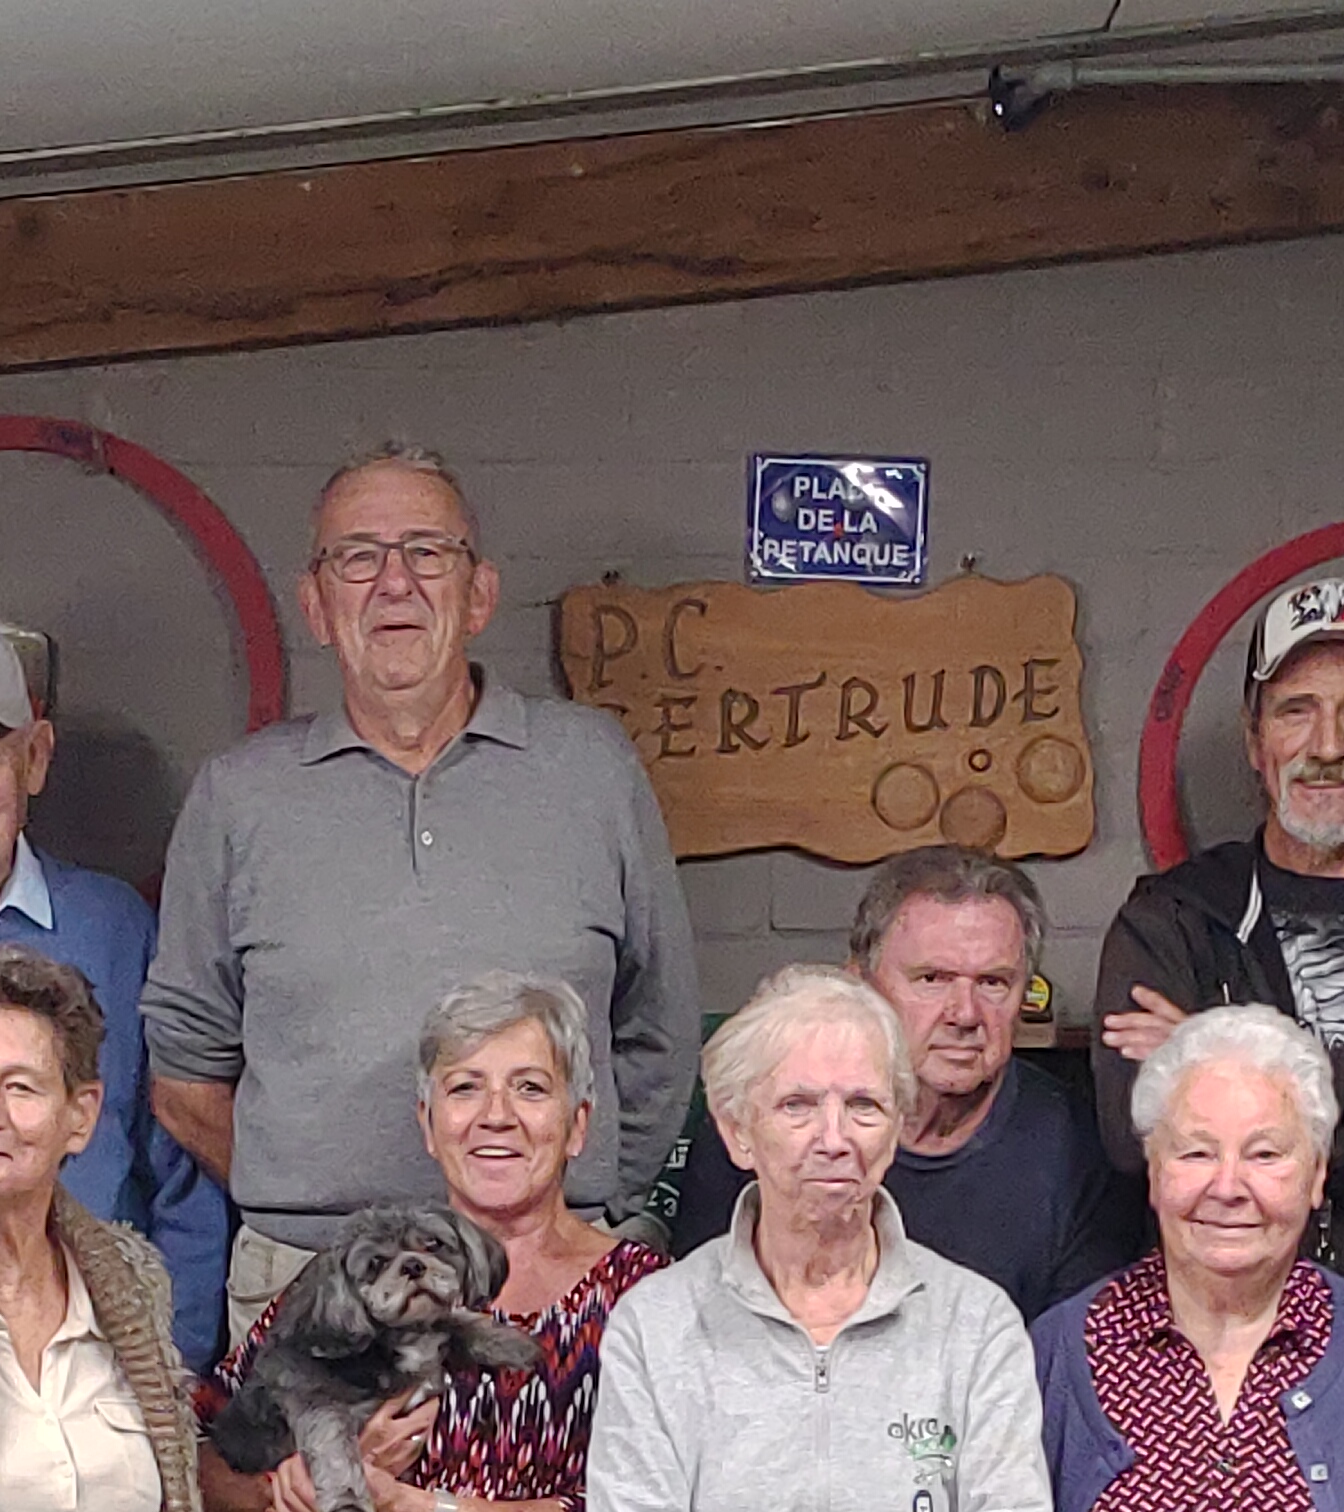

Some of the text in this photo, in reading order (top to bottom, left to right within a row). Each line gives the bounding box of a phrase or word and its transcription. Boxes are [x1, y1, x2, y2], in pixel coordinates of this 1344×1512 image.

[793, 475, 877, 501] PLAC
[798, 507, 878, 533] DE LA
